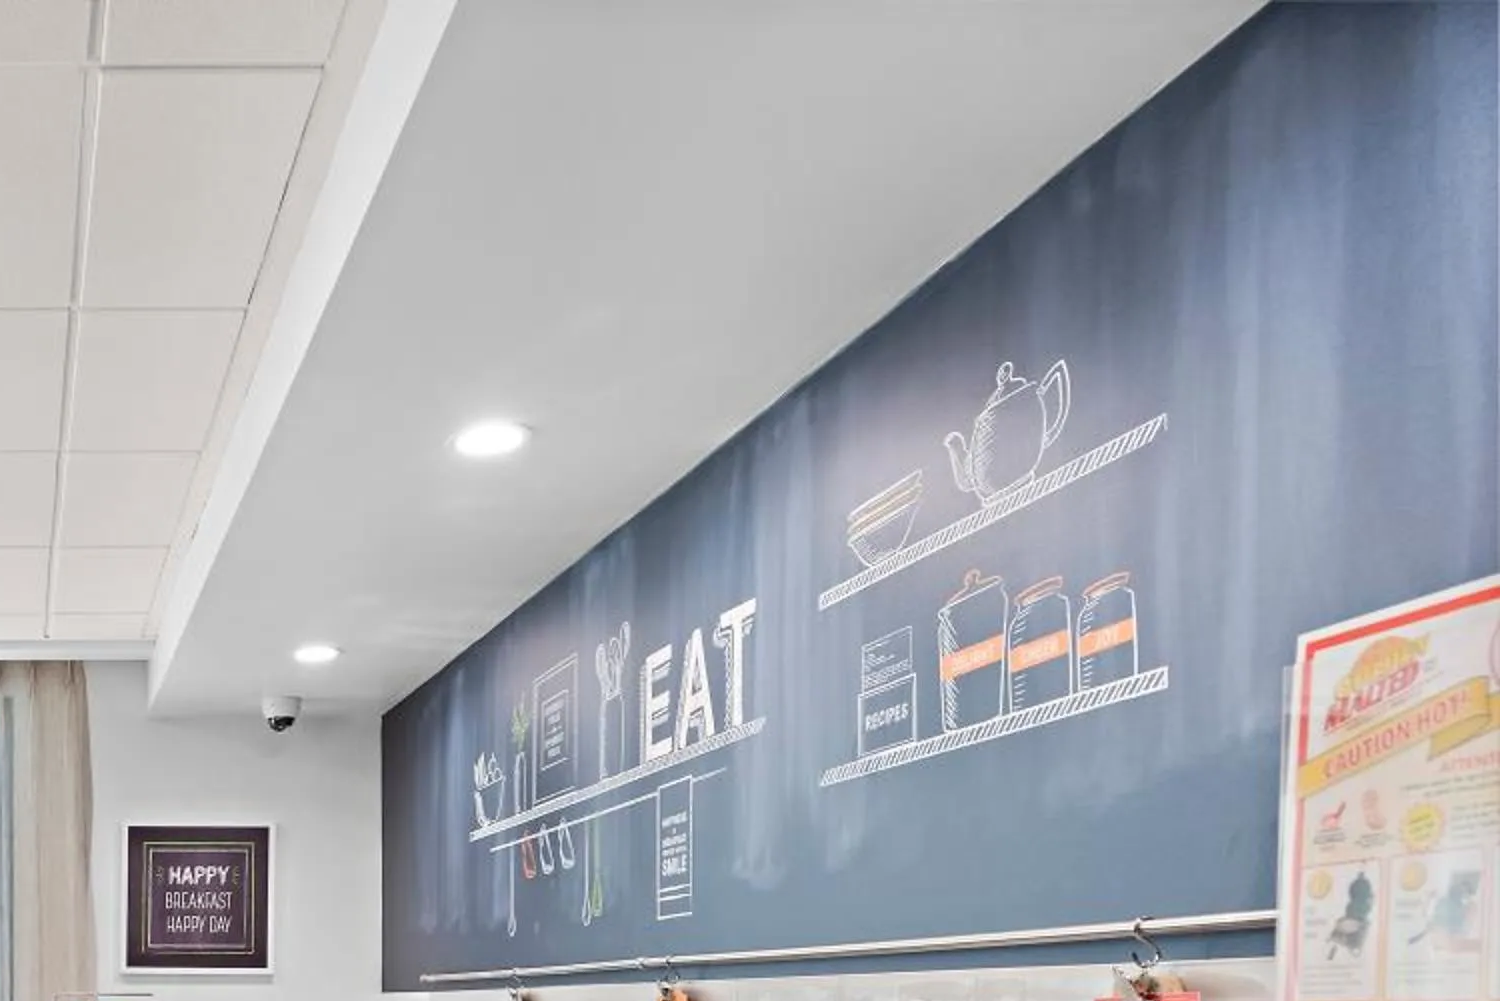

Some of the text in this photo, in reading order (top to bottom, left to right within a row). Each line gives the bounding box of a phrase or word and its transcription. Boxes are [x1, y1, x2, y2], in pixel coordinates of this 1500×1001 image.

[640, 598, 757, 765] EAT
[865, 703, 909, 731] RECIPES
[1323, 721, 1410, 779] CAUTION
[168, 865, 231, 885] HAPPY
[165, 891, 232, 909] BREAKFAST
[167, 915, 232, 933] HAPPY DAY
